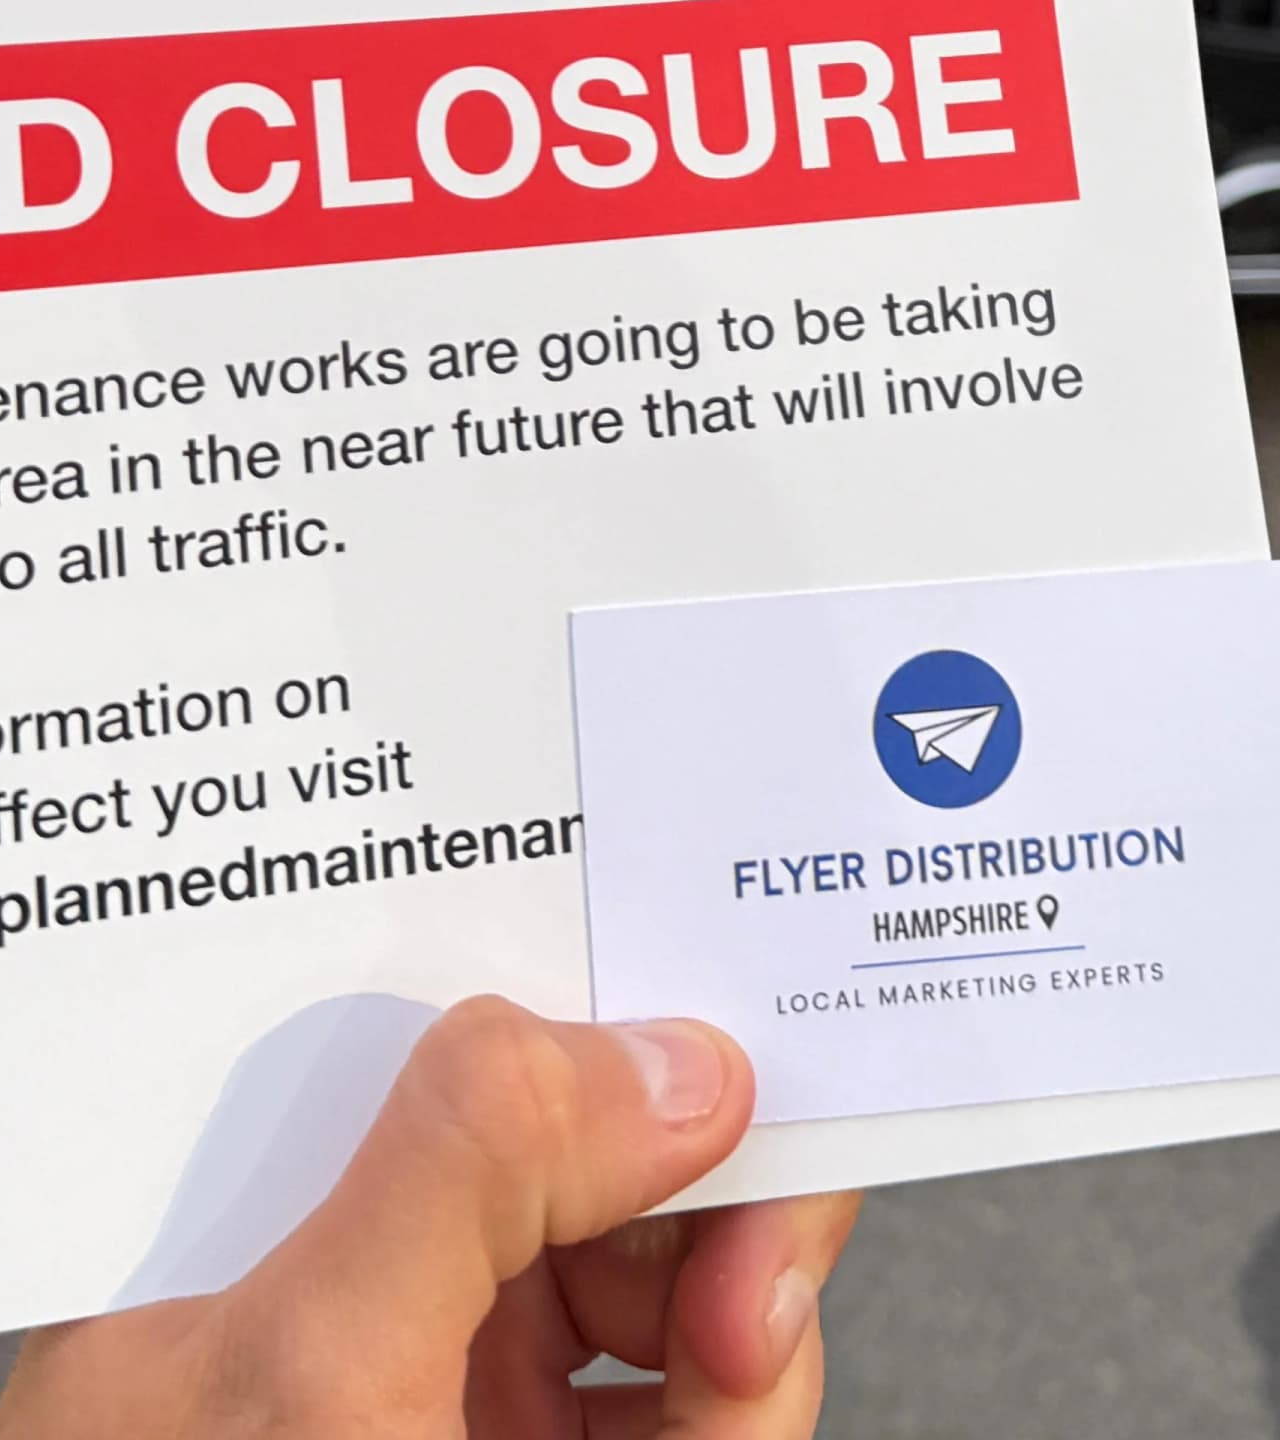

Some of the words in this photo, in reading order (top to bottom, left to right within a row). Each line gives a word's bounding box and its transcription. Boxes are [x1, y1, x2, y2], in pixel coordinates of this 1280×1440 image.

[177, 30, 1015, 218] CLOSURE
[226, 341, 406, 398] works
[430, 339, 517, 380] are
[540, 316, 699, 381] going
[718, 309, 774, 351] to
[795, 299, 864, 345] be
[882, 284, 1055, 336] taking
[110, 445, 160, 493] in
[183, 435, 280, 485] the
[304, 426, 433, 473] near
[452, 407, 622, 457] future
[642, 386, 755, 438] that
[774, 372, 864, 424] will
[885, 358, 1082, 414] involve
[60, 528, 125, 583] all
[149, 510, 344, 572] traffic.
[276, 675, 349, 718] on
[152, 772, 266, 837] you
[289, 742, 412, 802] visit
[735, 853, 865, 898] FLYER
[886, 827, 1184, 885] DISTRIBUTION
[874, 902, 1028, 941] HAMPSHIRE
[777, 990, 864, 1014] LOCAL
[879, 974, 1036, 1005] MARKETING
[1051, 963, 1163, 990] EXPERTS
